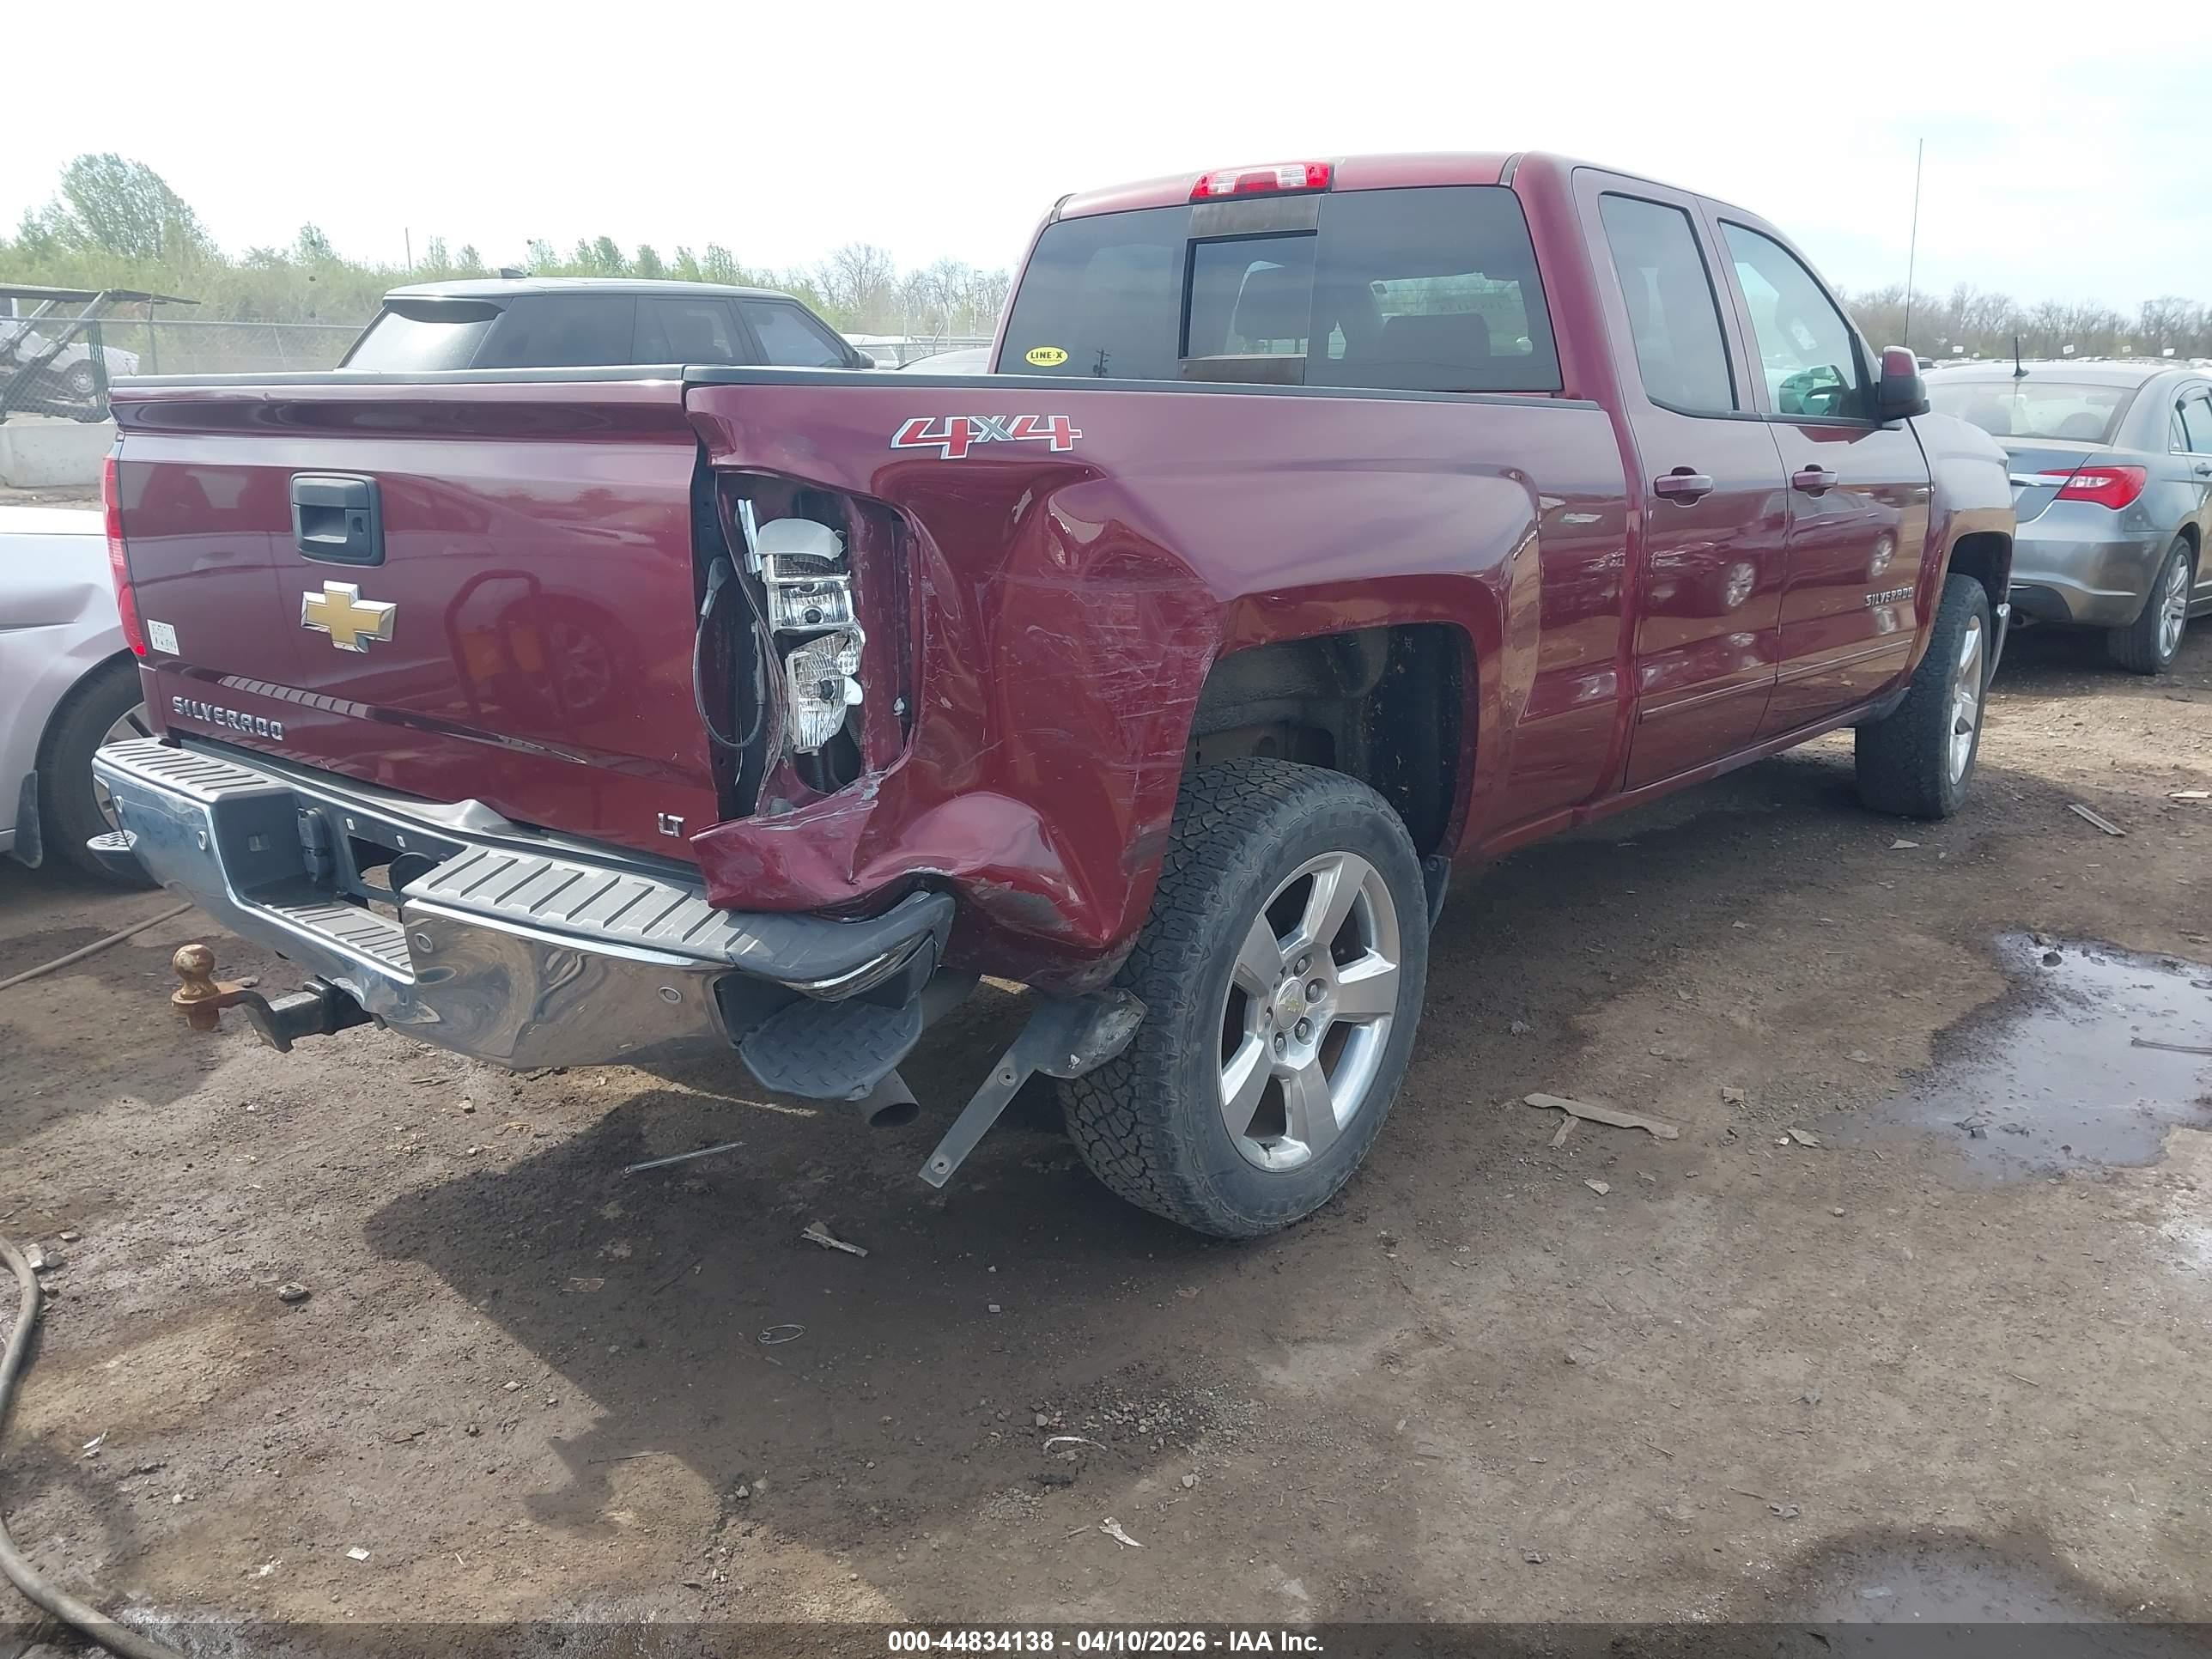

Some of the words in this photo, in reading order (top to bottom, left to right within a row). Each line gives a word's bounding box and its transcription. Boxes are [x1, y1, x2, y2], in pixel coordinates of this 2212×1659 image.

[1865, 586, 1914, 606] SILVERADO
[172, 696, 283, 741] SILVERADO
[658, 812, 684, 838] LT
